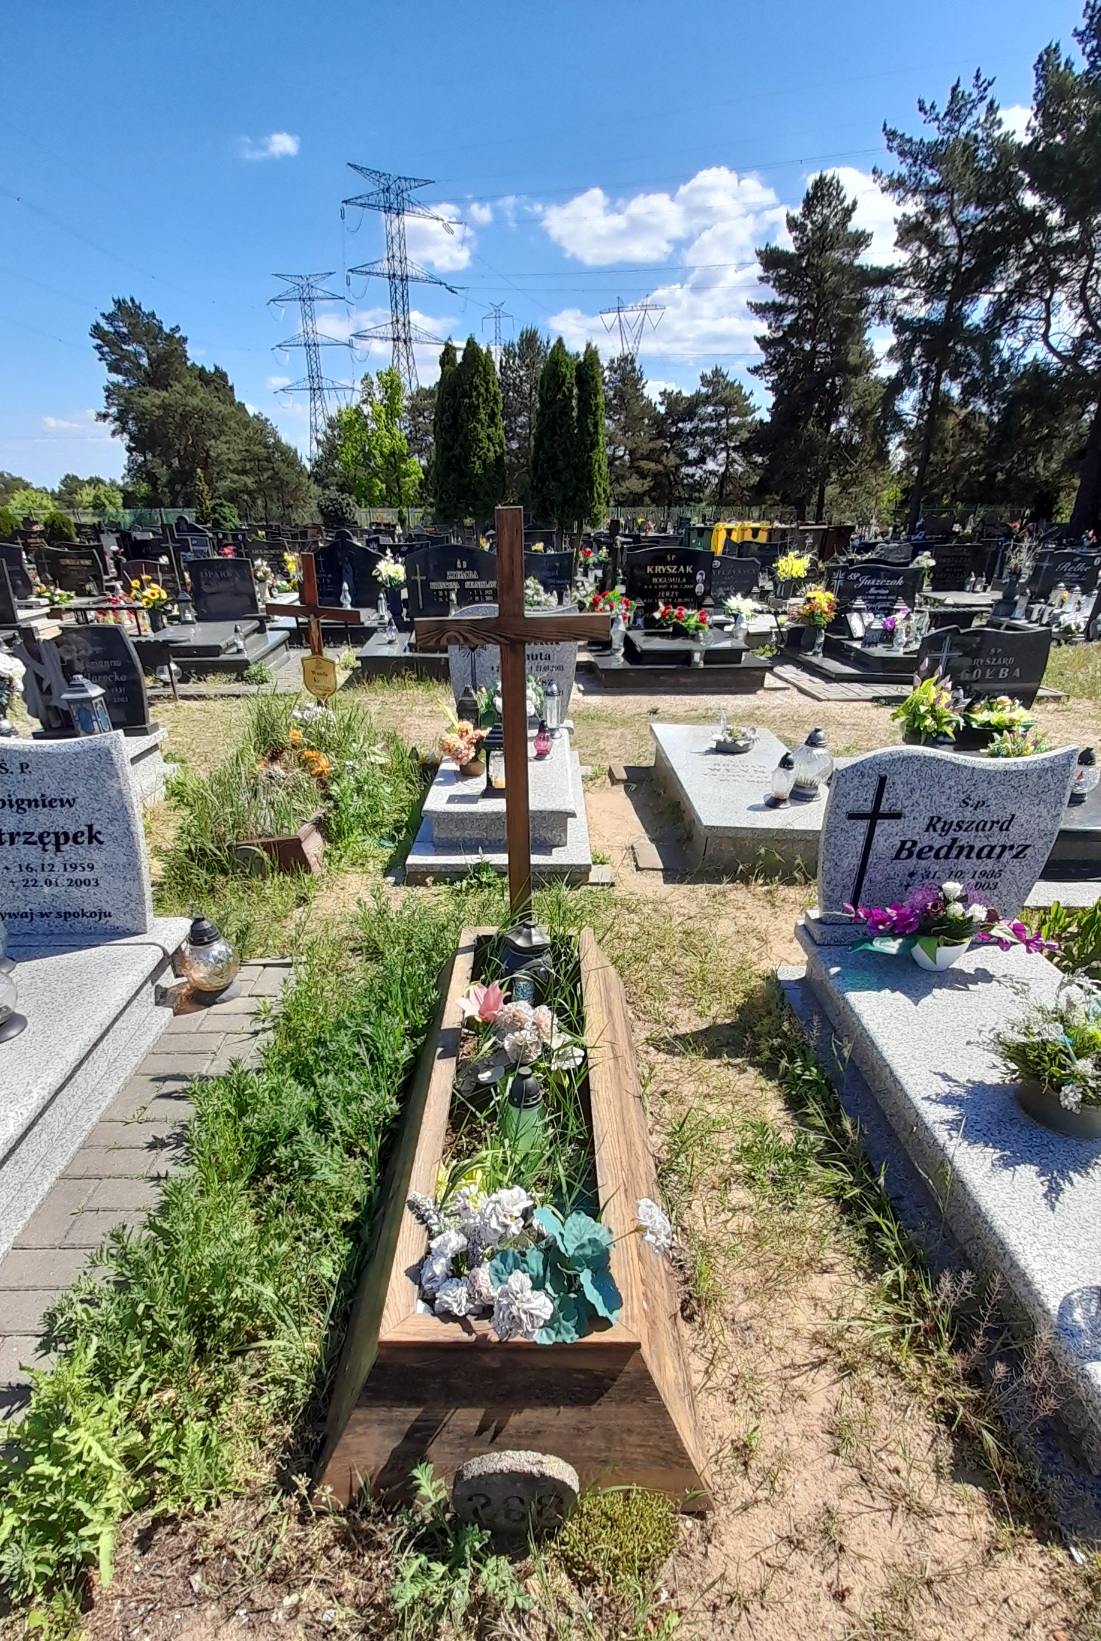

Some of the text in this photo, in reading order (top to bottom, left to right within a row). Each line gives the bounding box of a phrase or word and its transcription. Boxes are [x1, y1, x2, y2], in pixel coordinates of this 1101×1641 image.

[646, 565, 694, 574] KRYSZAK
[657, 590, 680, 598] JERZY
[973, 657, 1015, 667] RYSZARD
[923, 814, 1016, 837] Ryszard
[890, 838, 1032, 861] Bednarz
[18, 863, 95, 873] 16.12.1959
[22, 878, 100, 888] 22.01.2003
[41, 911, 53, 919] w
[54, 908, 112, 922] spokoju
